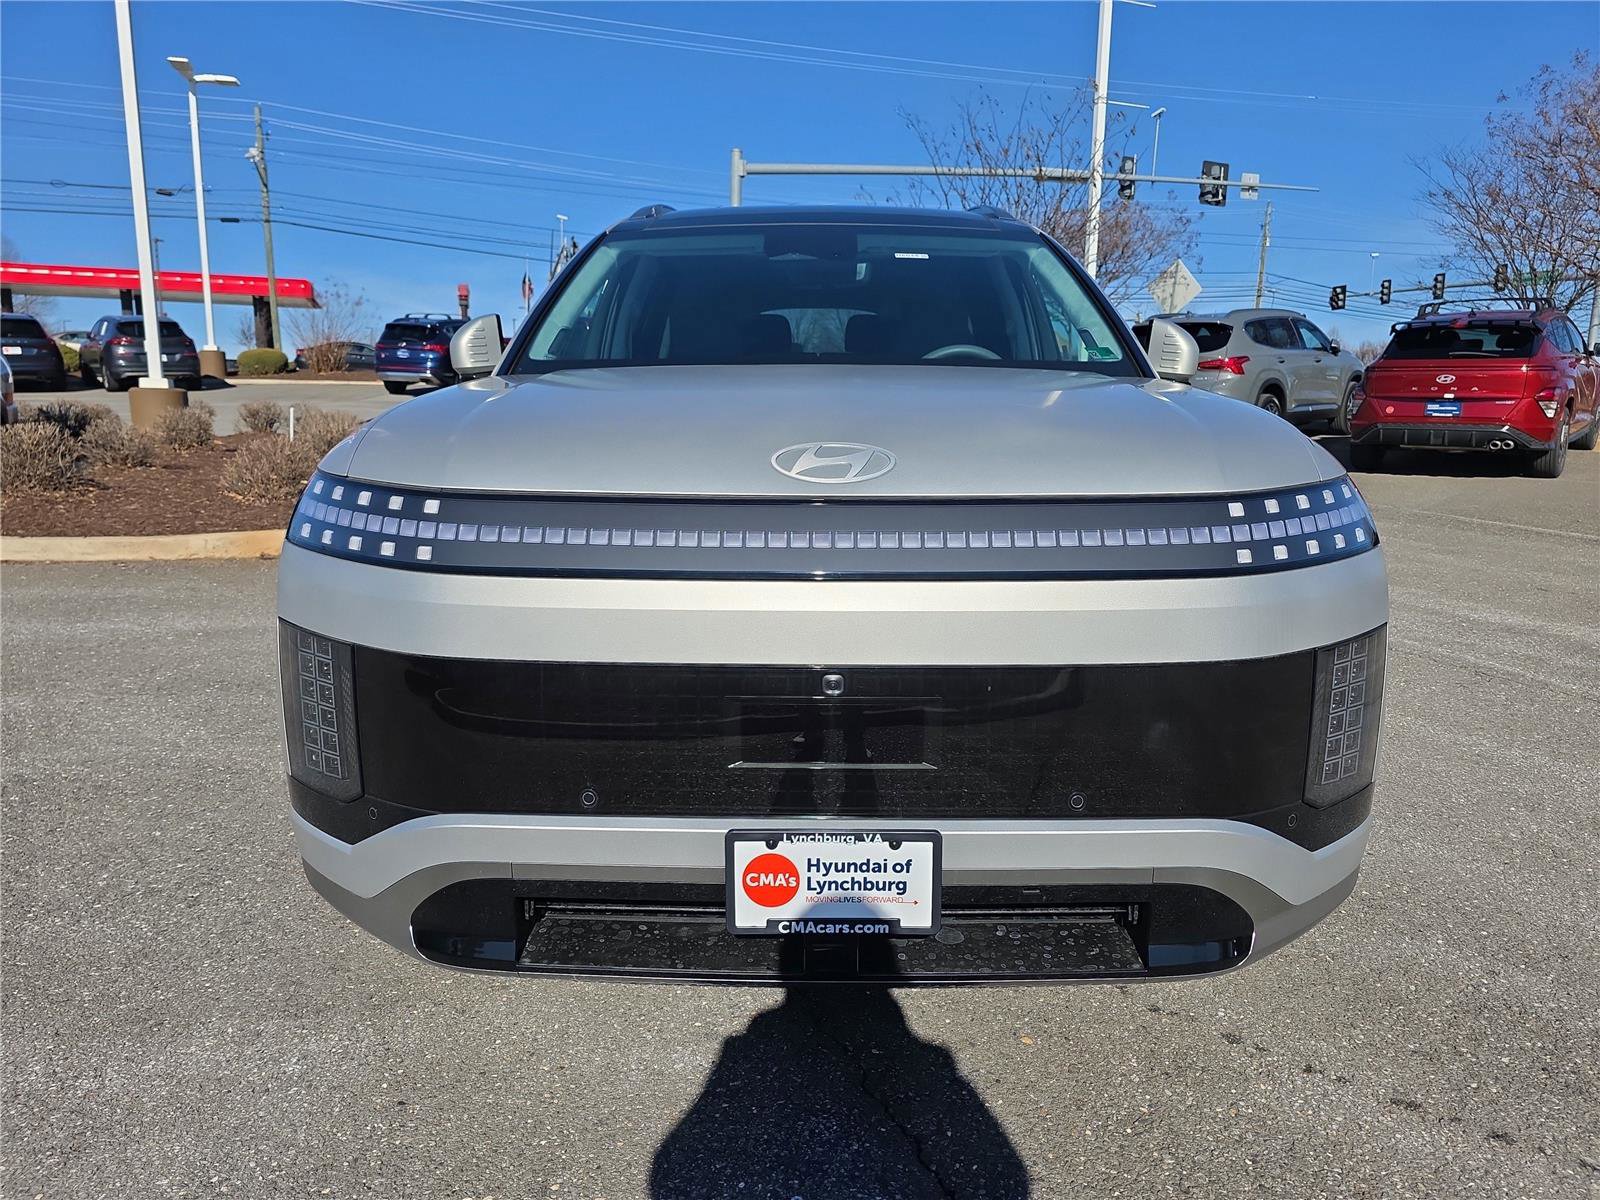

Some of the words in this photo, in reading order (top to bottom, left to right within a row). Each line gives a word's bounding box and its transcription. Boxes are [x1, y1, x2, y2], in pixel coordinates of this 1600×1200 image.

[783, 833, 859, 845] Lynchburg,
[864, 833, 883, 843] VA
[807, 858, 888, 876] Hyundai
[892, 859, 913, 874] of
[745, 872, 798, 888] CMA's
[806, 877, 908, 895] Lynchburg
[778, 921, 889, 934] CMAcars.com
